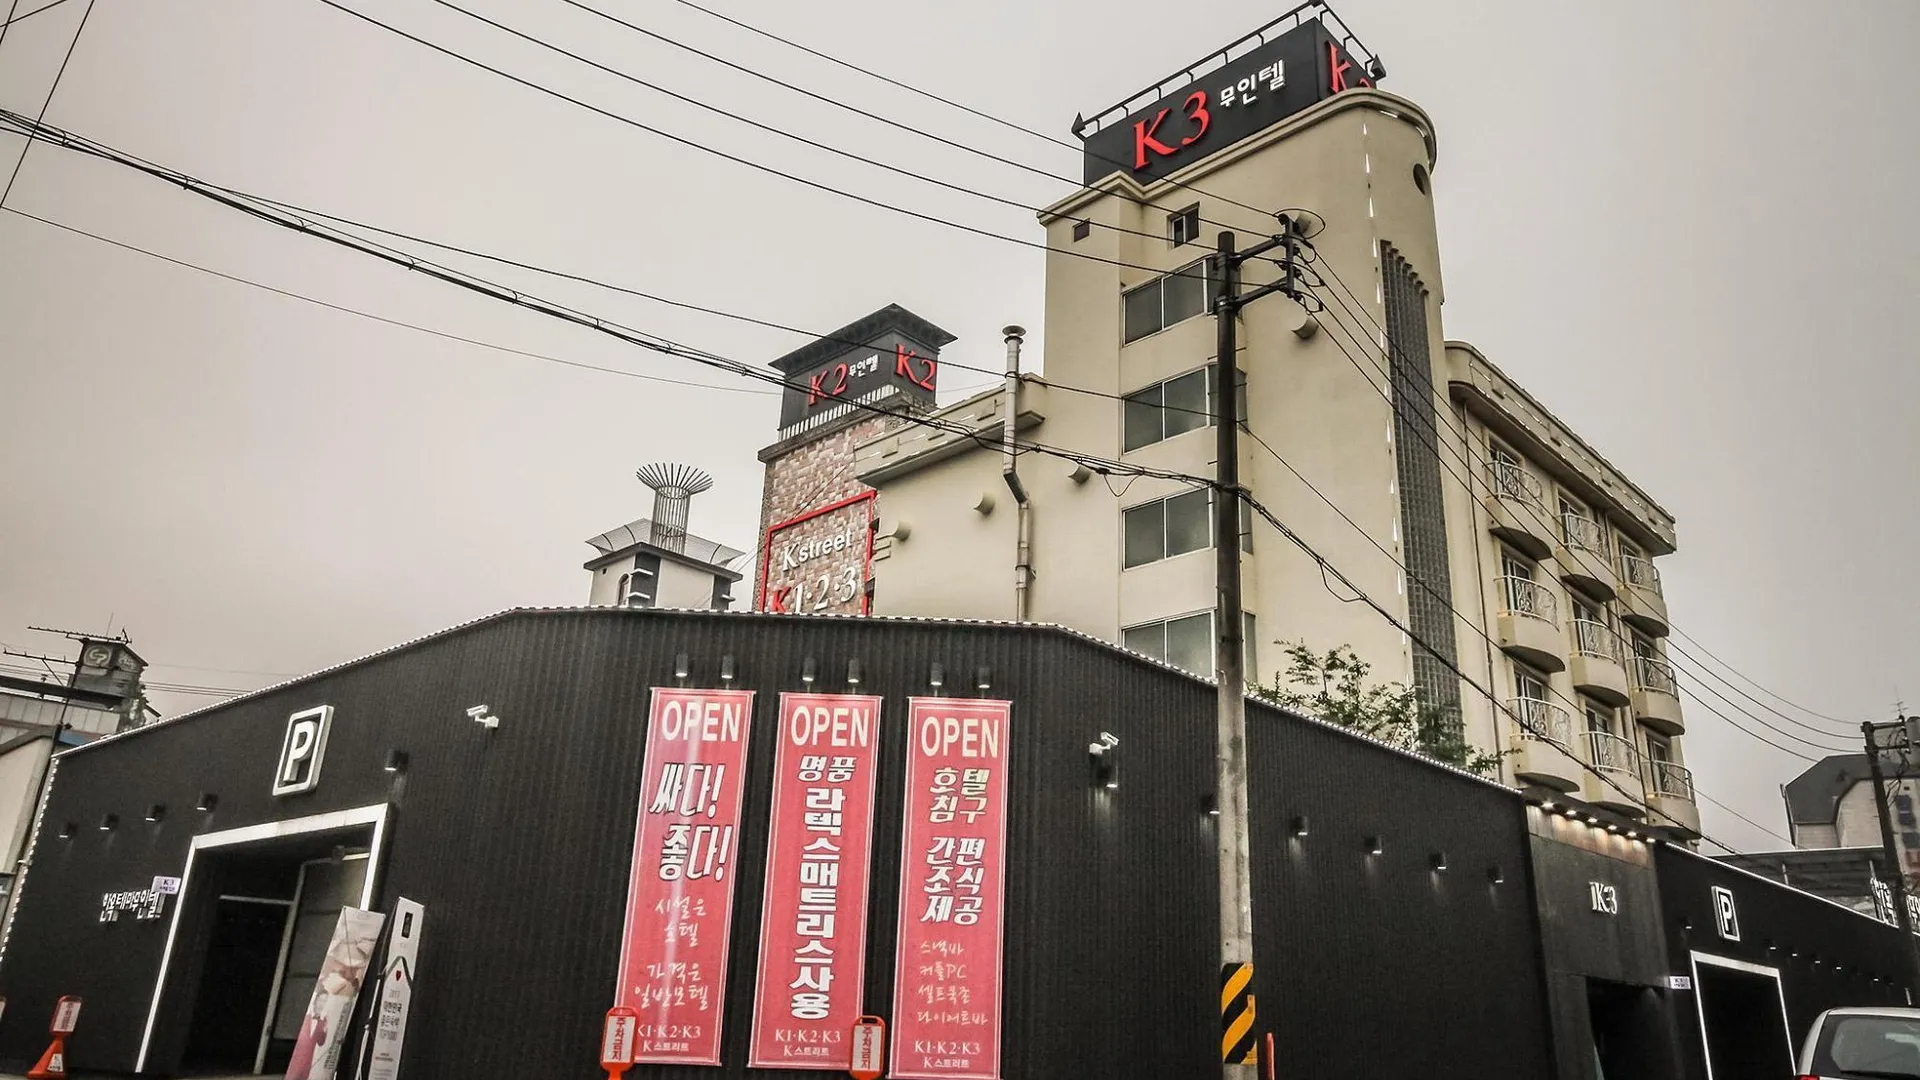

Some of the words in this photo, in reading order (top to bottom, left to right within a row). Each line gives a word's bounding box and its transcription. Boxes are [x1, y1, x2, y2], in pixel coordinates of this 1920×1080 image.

[1326, 40, 1372, 95] K
[1132, 89, 1211, 171] K3
[1219, 58, 1286, 108] 무인텔
[808, 363, 848, 406] K2
[848, 354, 879, 378] 무인텔
[895, 342, 936, 392] K2
[661, 700, 741, 742] OPEN
[791, 705, 870, 747] OPEN
[921, 716, 999, 759] OPEN
[283, 720, 318, 782] P
[797, 755, 857, 783] 명품
[648, 762, 726, 819] 싸다!
[929, 767, 991, 796] 호텔
[929, 795, 988, 824] 침구
[658, 823, 733, 881] 좋다!
[926, 836, 986, 866] 간편
[923, 866, 985, 895] 조식
[1588, 881, 1618, 915] K3
[654, 896, 707, 920] 시설은
[920, 895, 983, 926] 제공
[647, 962, 702, 985] 가격은
[634, 985, 709, 1011] 일반모텔
